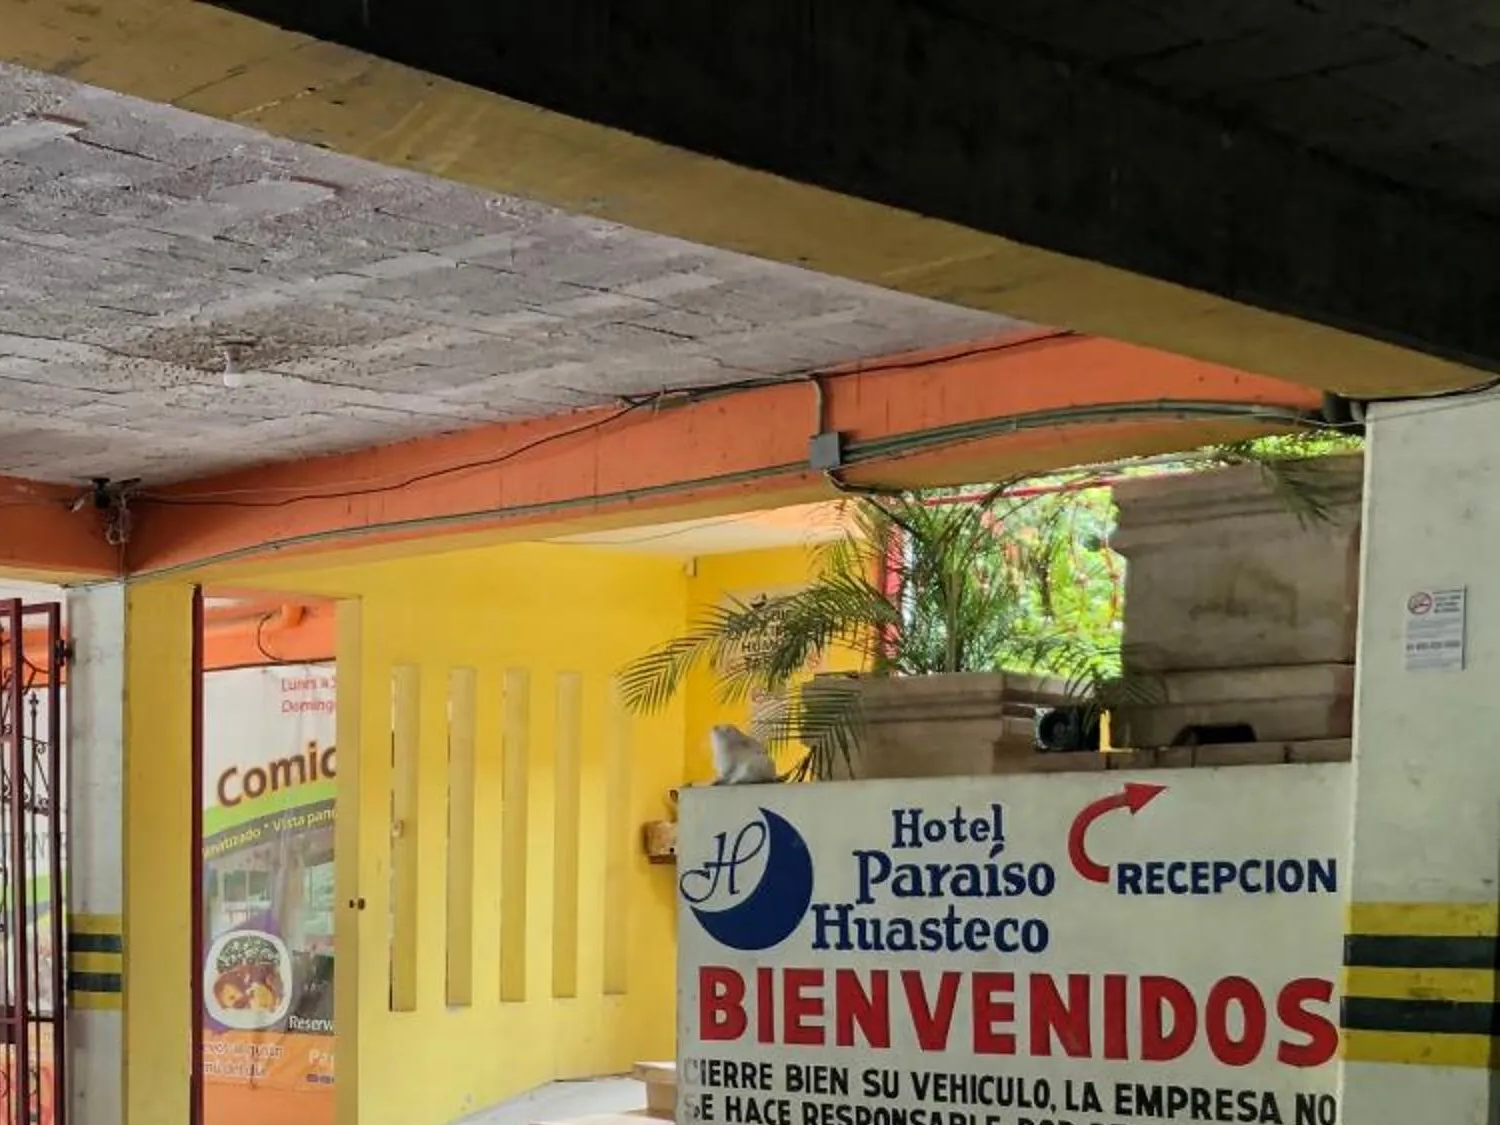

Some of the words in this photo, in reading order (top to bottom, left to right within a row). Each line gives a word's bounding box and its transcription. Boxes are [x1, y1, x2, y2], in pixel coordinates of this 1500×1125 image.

[281, 699, 336, 715] Doming
[891, 803, 1005, 849] Hotel
[852, 843, 1056, 905] Paraíso
[1116, 857, 1338, 896] RECEPCION
[810, 903, 1049, 954] Huasteco
[697, 965, 1340, 1068] BIENVENIDOS
[786, 1063, 850, 1097] BIEN
[862, 1069, 900, 1101] SU
[1065, 1079, 1103, 1114] LA
